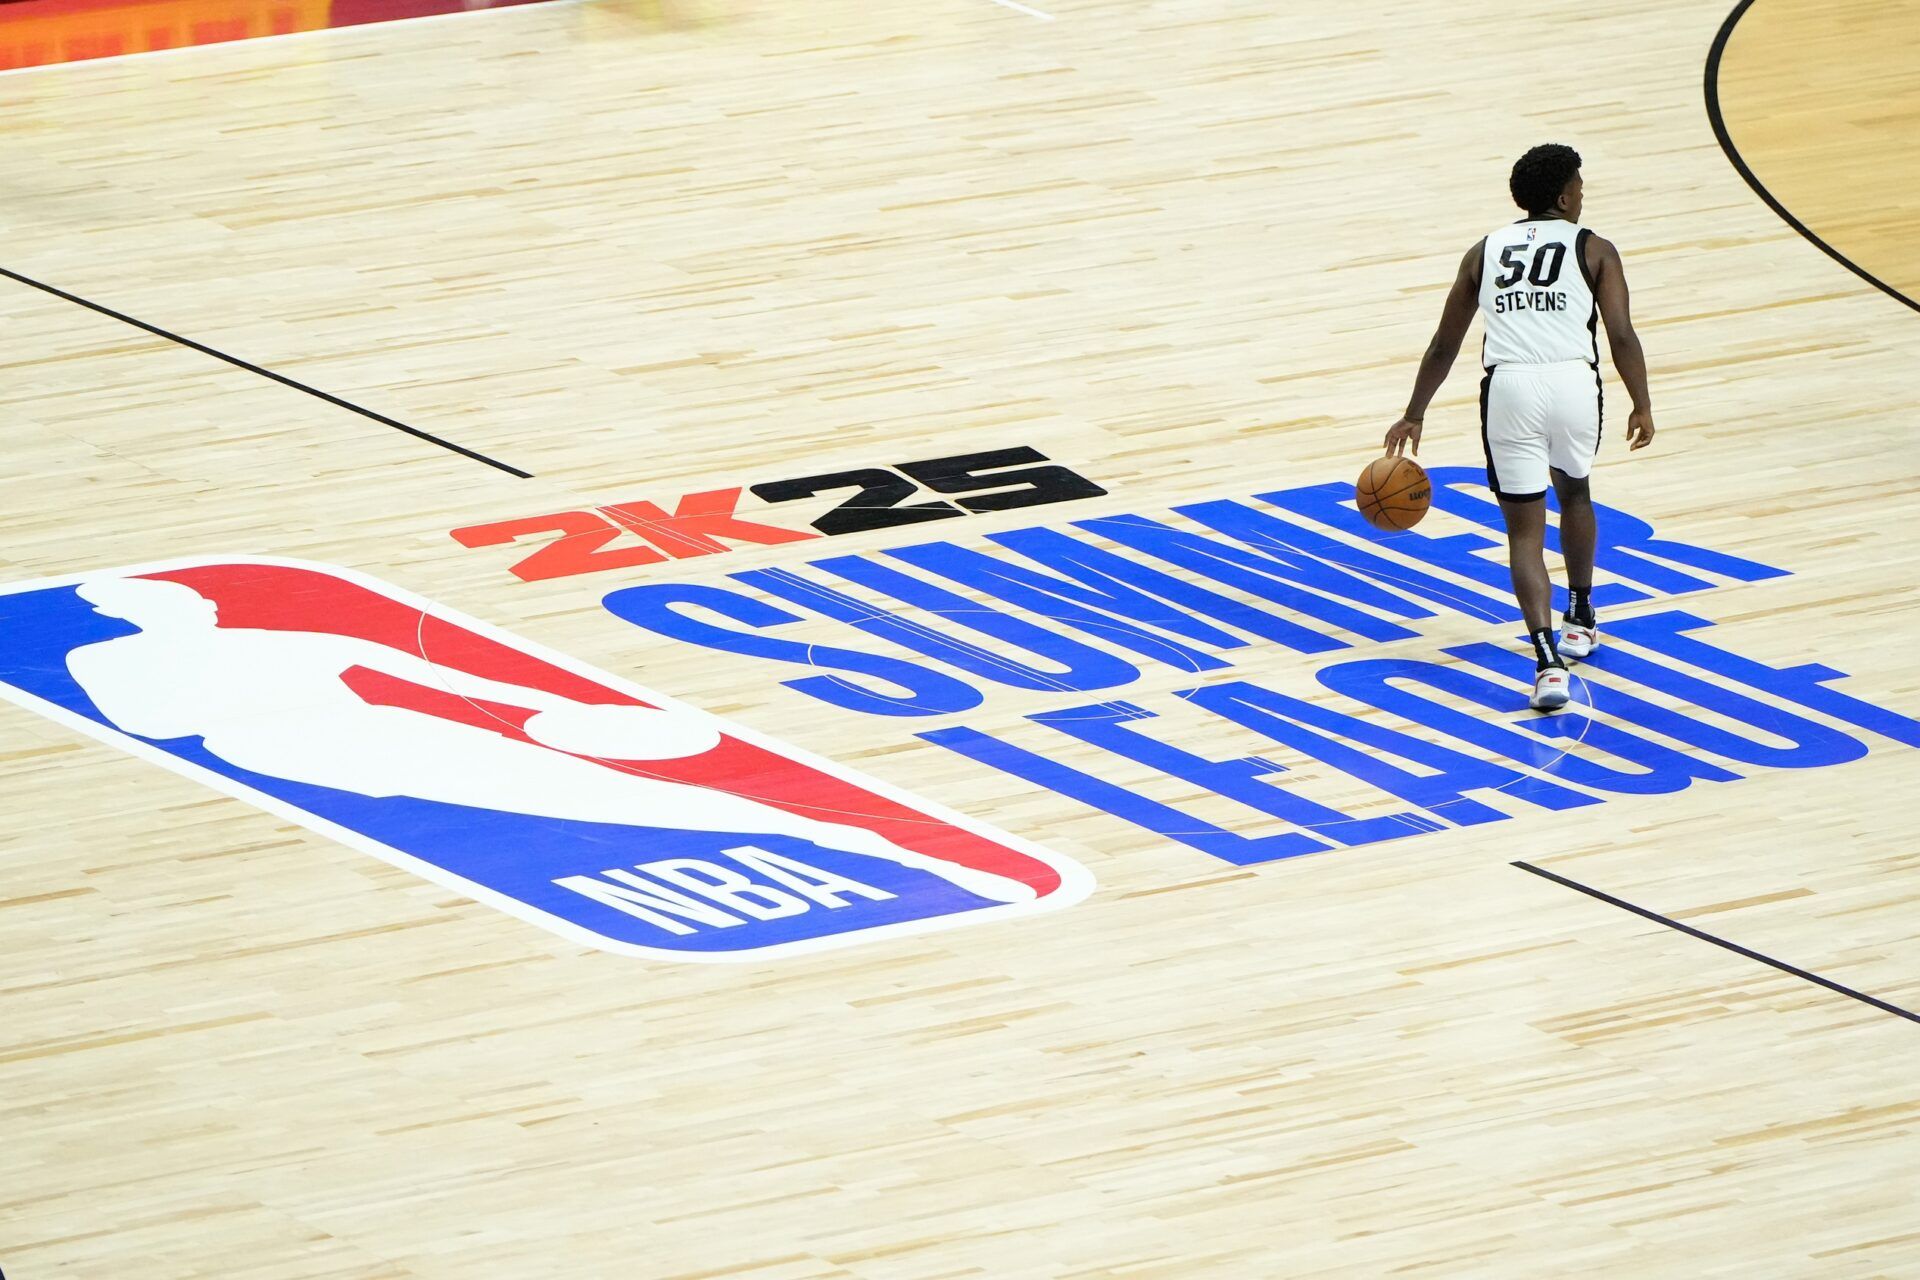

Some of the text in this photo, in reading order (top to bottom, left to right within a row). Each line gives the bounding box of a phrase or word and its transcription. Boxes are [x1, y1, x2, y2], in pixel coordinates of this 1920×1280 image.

[1495, 242, 1567, 289] 50
[1495, 291, 1567, 313] STEVENS
[449, 446, 1108, 583] 2K25
[601, 465, 1792, 717] SUMMER
[918, 609, 1920, 866] LEAGUE
[552, 844, 899, 936] NBA
